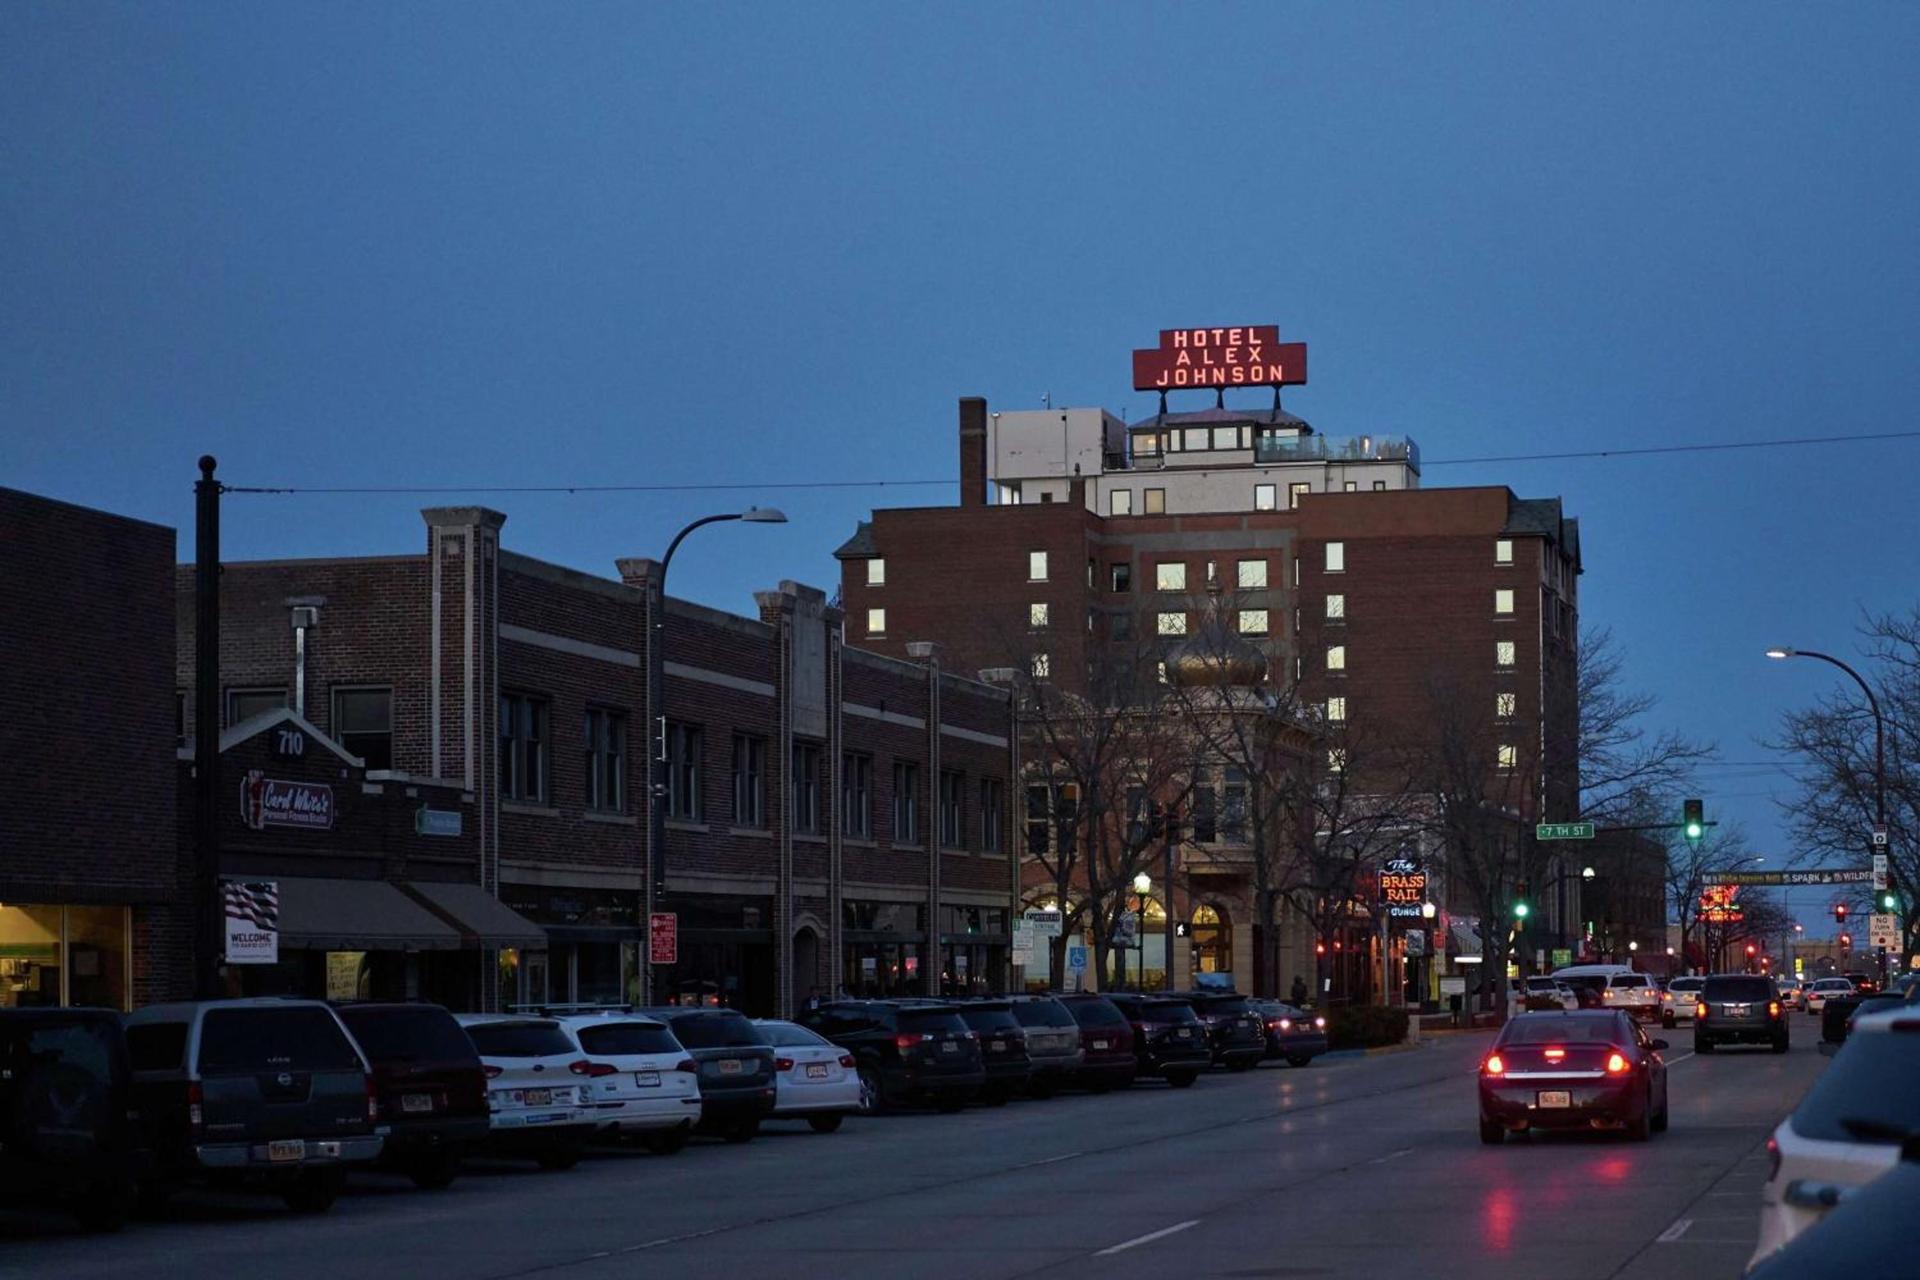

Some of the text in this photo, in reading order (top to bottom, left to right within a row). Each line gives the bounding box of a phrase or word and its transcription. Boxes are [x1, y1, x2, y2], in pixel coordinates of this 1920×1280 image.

[1174, 327, 1262, 347] HOTEL
[1176, 347, 1262, 366] ALEX
[1156, 365, 1283, 386] JOHNSON
[278, 730, 304, 755] 710
[1545, 825, 1585, 836] 7 TH ST
[1387, 859, 1416, 872] The
[1382, 876, 1424, 888] BRASS
[1791, 873, 1821, 884] SPARK
[1843, 870, 1875, 881] WILDFI
[1387, 889, 1420, 900] RAIL
[1390, 907, 1420, 916] OUNGE
[231, 933, 272, 943] WELCOME
